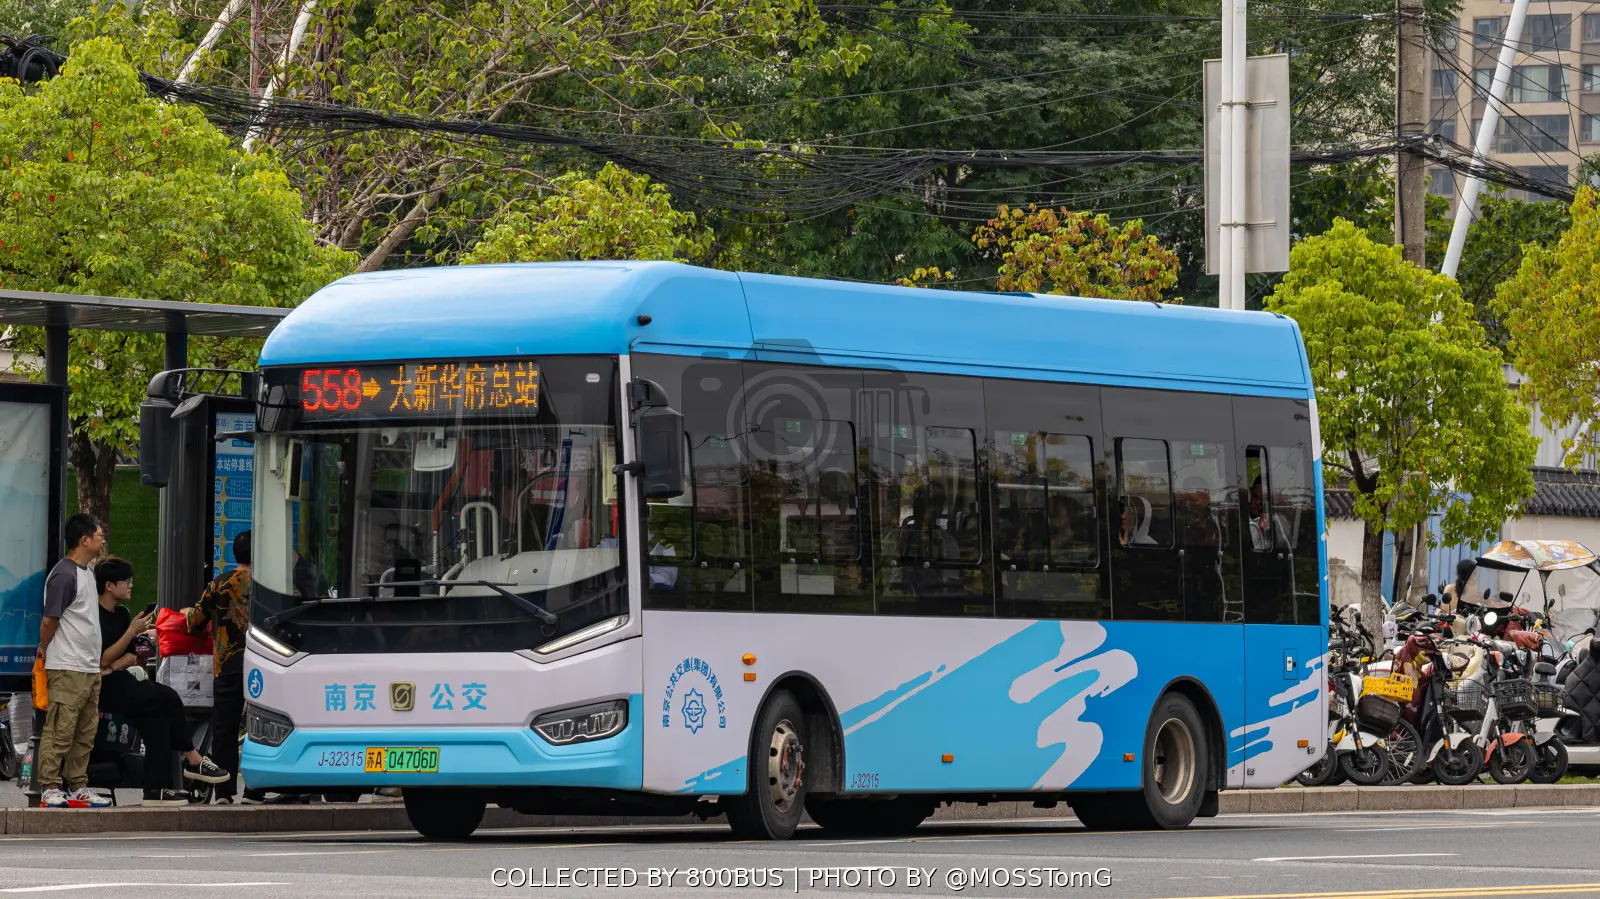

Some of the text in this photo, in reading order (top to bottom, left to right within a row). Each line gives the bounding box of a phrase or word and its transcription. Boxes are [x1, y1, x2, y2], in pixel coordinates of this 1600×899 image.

[302, 361, 538, 411] 558 大新华府总站
[325, 682, 487, 712] 南京 公交
[318, 751, 363, 767] J-32315
[850, 773, 879, 788] J-32315
